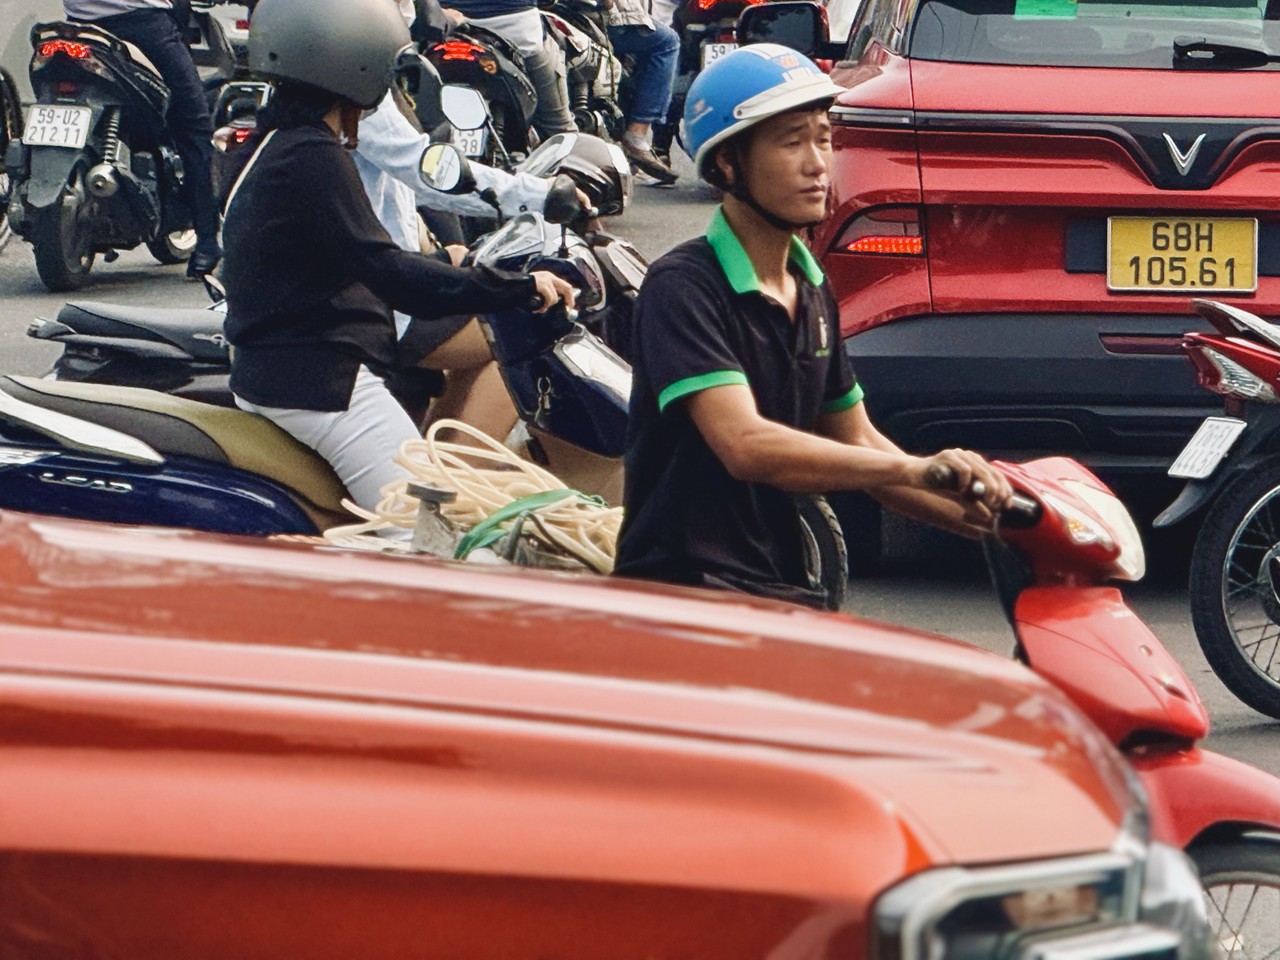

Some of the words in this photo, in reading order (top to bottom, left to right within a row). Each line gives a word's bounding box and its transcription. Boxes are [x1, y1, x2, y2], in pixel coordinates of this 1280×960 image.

[37, 108, 81, 126] 59-U2
[28, 125, 81, 145] 21211
[1152, 222, 1213, 252] 68H
[1130, 256, 1236, 286] 105.61
